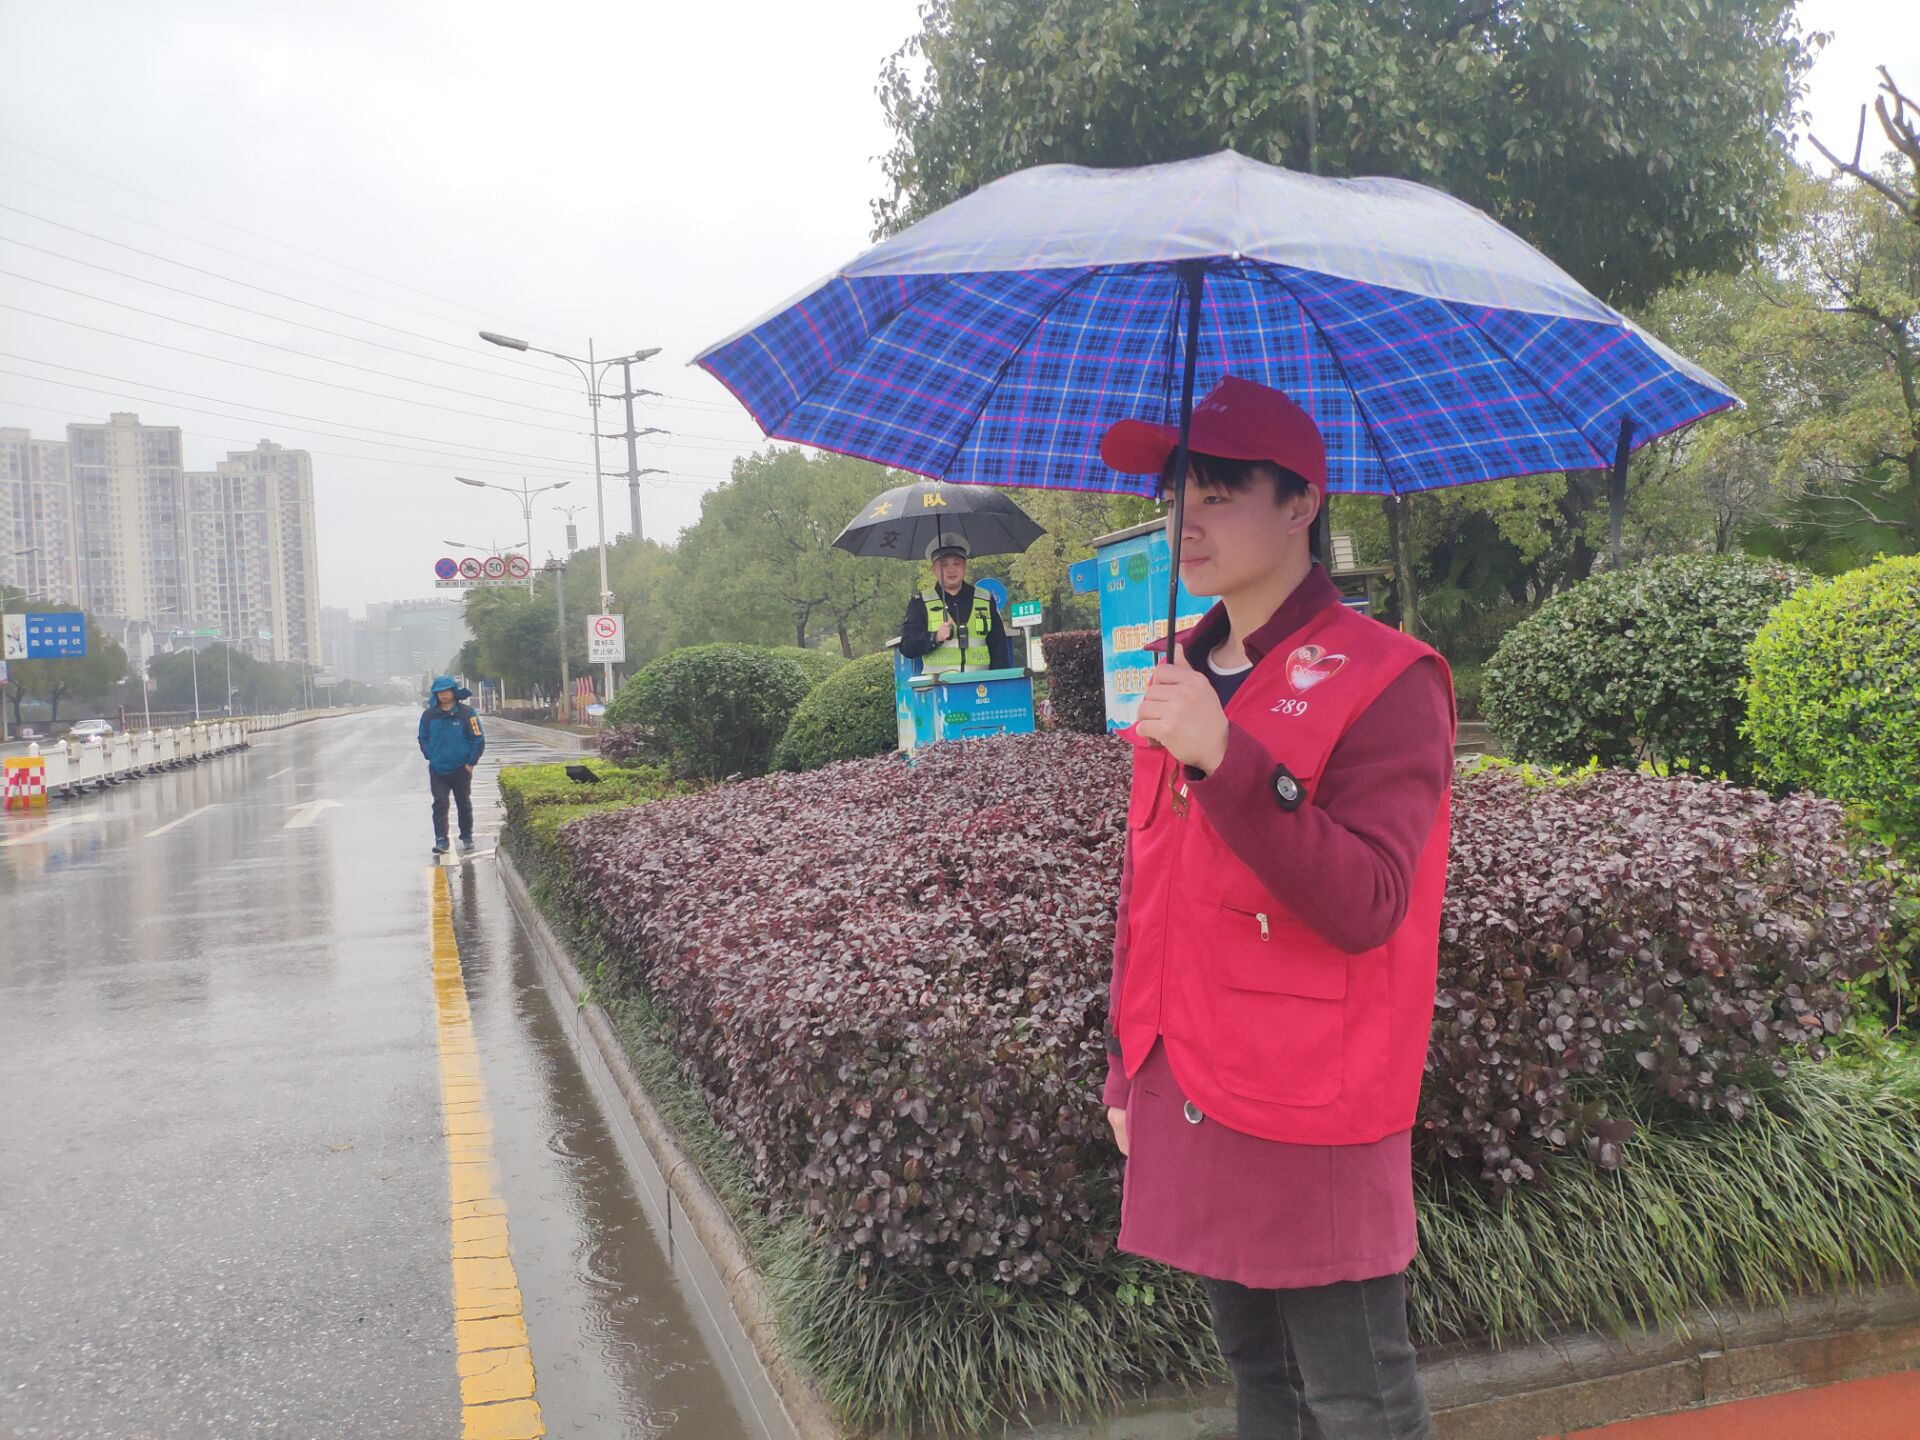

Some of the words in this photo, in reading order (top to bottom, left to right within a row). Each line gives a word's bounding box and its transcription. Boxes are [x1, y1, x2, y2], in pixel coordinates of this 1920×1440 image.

[869, 501, 893, 519] 大
[923, 492, 947, 509] 队
[489, 562, 502, 573] 50
[1270, 698, 1308, 717] 289
